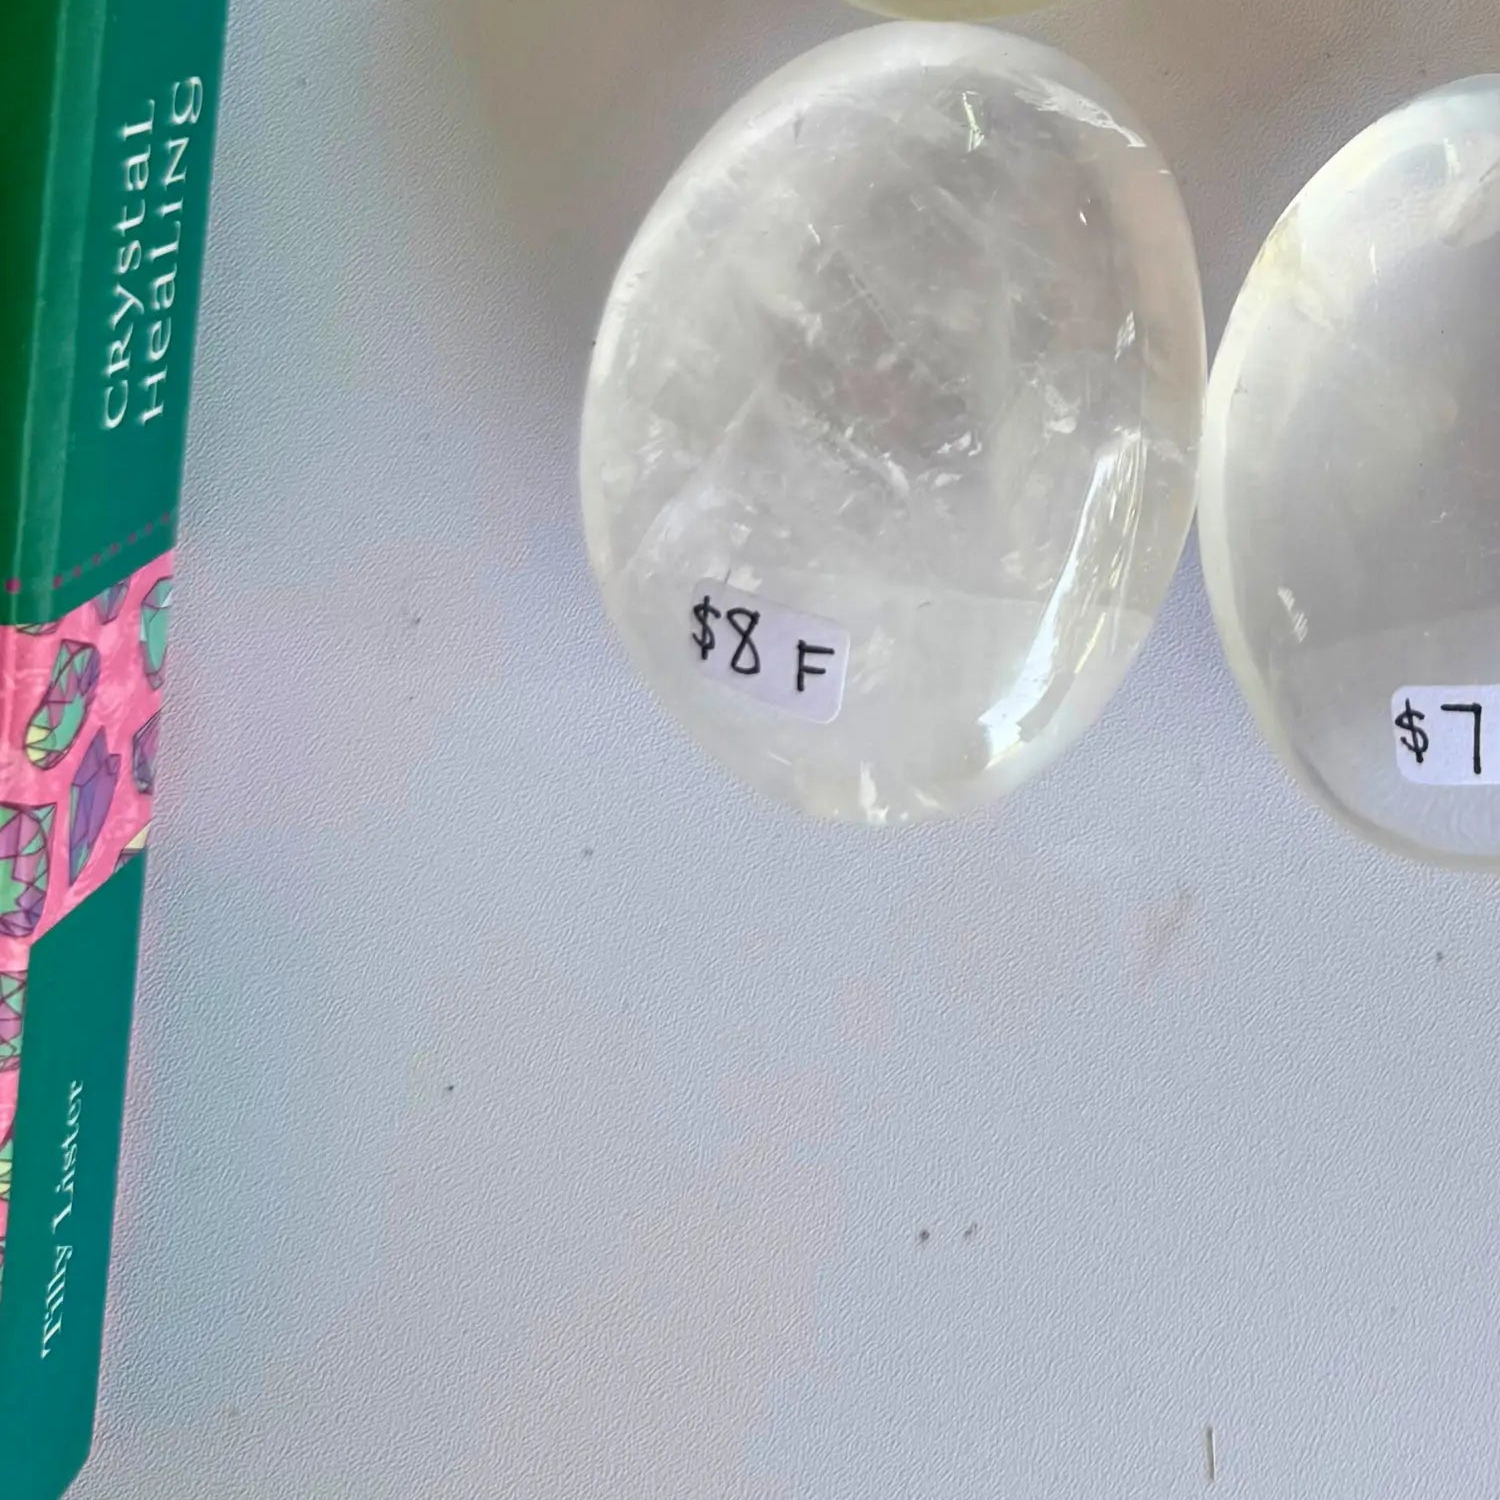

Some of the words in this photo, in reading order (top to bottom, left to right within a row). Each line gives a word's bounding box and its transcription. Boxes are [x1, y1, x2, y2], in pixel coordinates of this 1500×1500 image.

[692, 594, 761, 675] $8
[796, 638, 836, 693] F
[51, 1079, 84, 1235] Lister
[41, 1244, 73, 1361] Tilly
